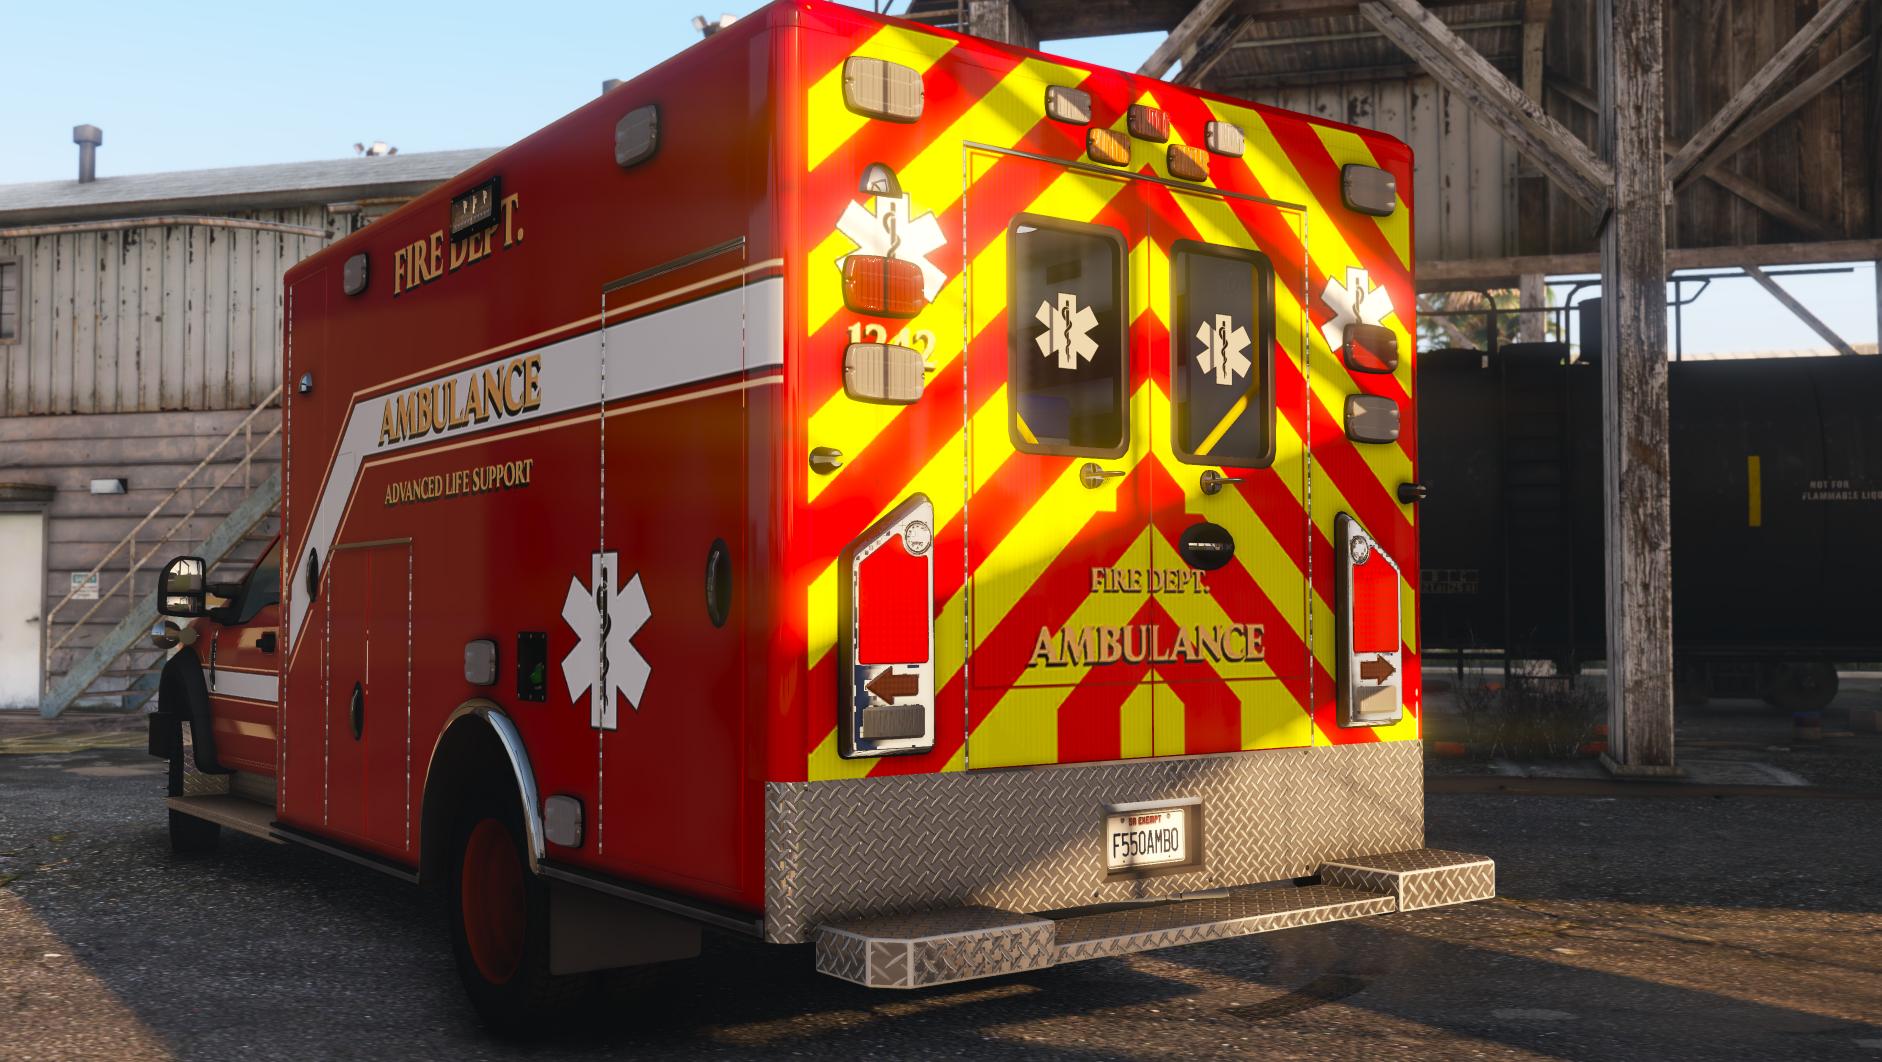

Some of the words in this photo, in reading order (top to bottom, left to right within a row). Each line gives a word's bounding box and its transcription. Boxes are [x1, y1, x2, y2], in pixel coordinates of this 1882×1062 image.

[393, 230, 444, 296] FIRE
[378, 354, 542, 448] AMBULANCE
[384, 475, 443, 506] ADVANCED
[445, 470, 470, 497] LIFE
[472, 459, 534, 494] SUPPORT
[1091, 566, 1143, 593] FIRE
[1147, 567, 1211, 594] DEPT.
[1026, 623, 1266, 667] AMBULANCE
[1138, 814, 1162, 825] EXEMPT
